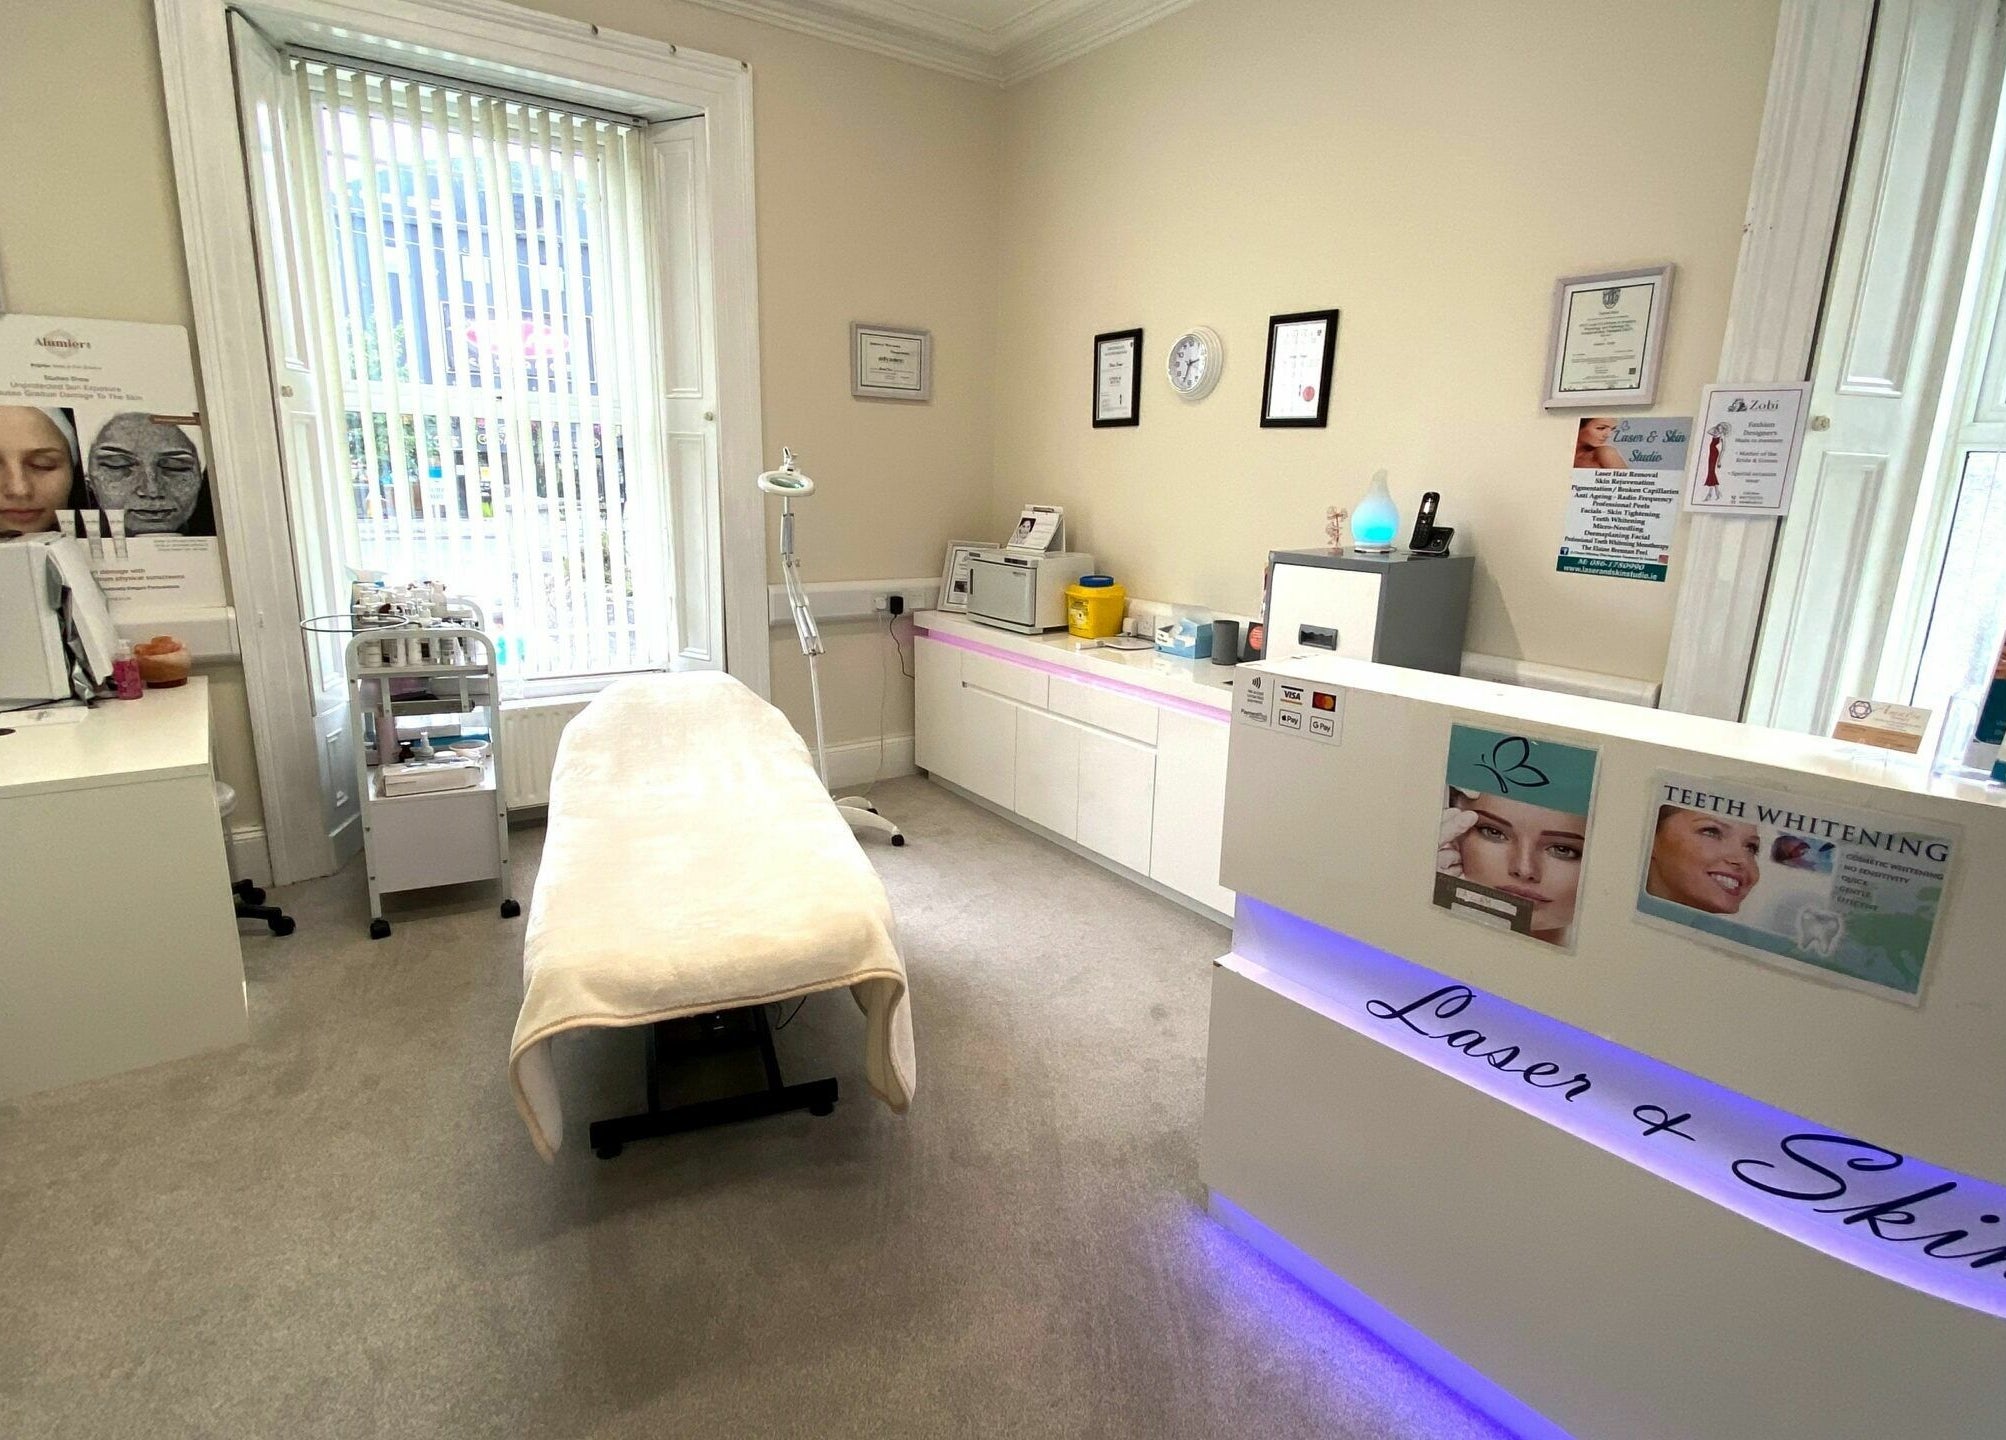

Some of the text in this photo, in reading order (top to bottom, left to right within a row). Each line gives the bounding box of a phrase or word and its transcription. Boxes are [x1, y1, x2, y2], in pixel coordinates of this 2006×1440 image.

[1749, 399, 1780, 411] Zobi
[1613, 429, 1687, 443] Laser & Skin
[1743, 429, 1777, 437] Designers
[1628, 449, 1663, 463] Studio
[1638, 495, 1673, 503] Frequency
[1624, 509, 1660, 519] Tightening
[1611, 517, 1646, 525] Whitening
[1592, 523, 1644, 533] Micro-Needling
[1584, 530, 1630, 539] Dermaplaning
[1284, 690, 1301, 701] VISA
[1286, 715, 1299, 725] Pay
[1320, 723, 1331, 732] Pay
[1664, 784, 1950, 863] TEETH WHITENING
[1843, 864, 1857, 872] NO
[1366, 985, 1592, 1102] Laser
